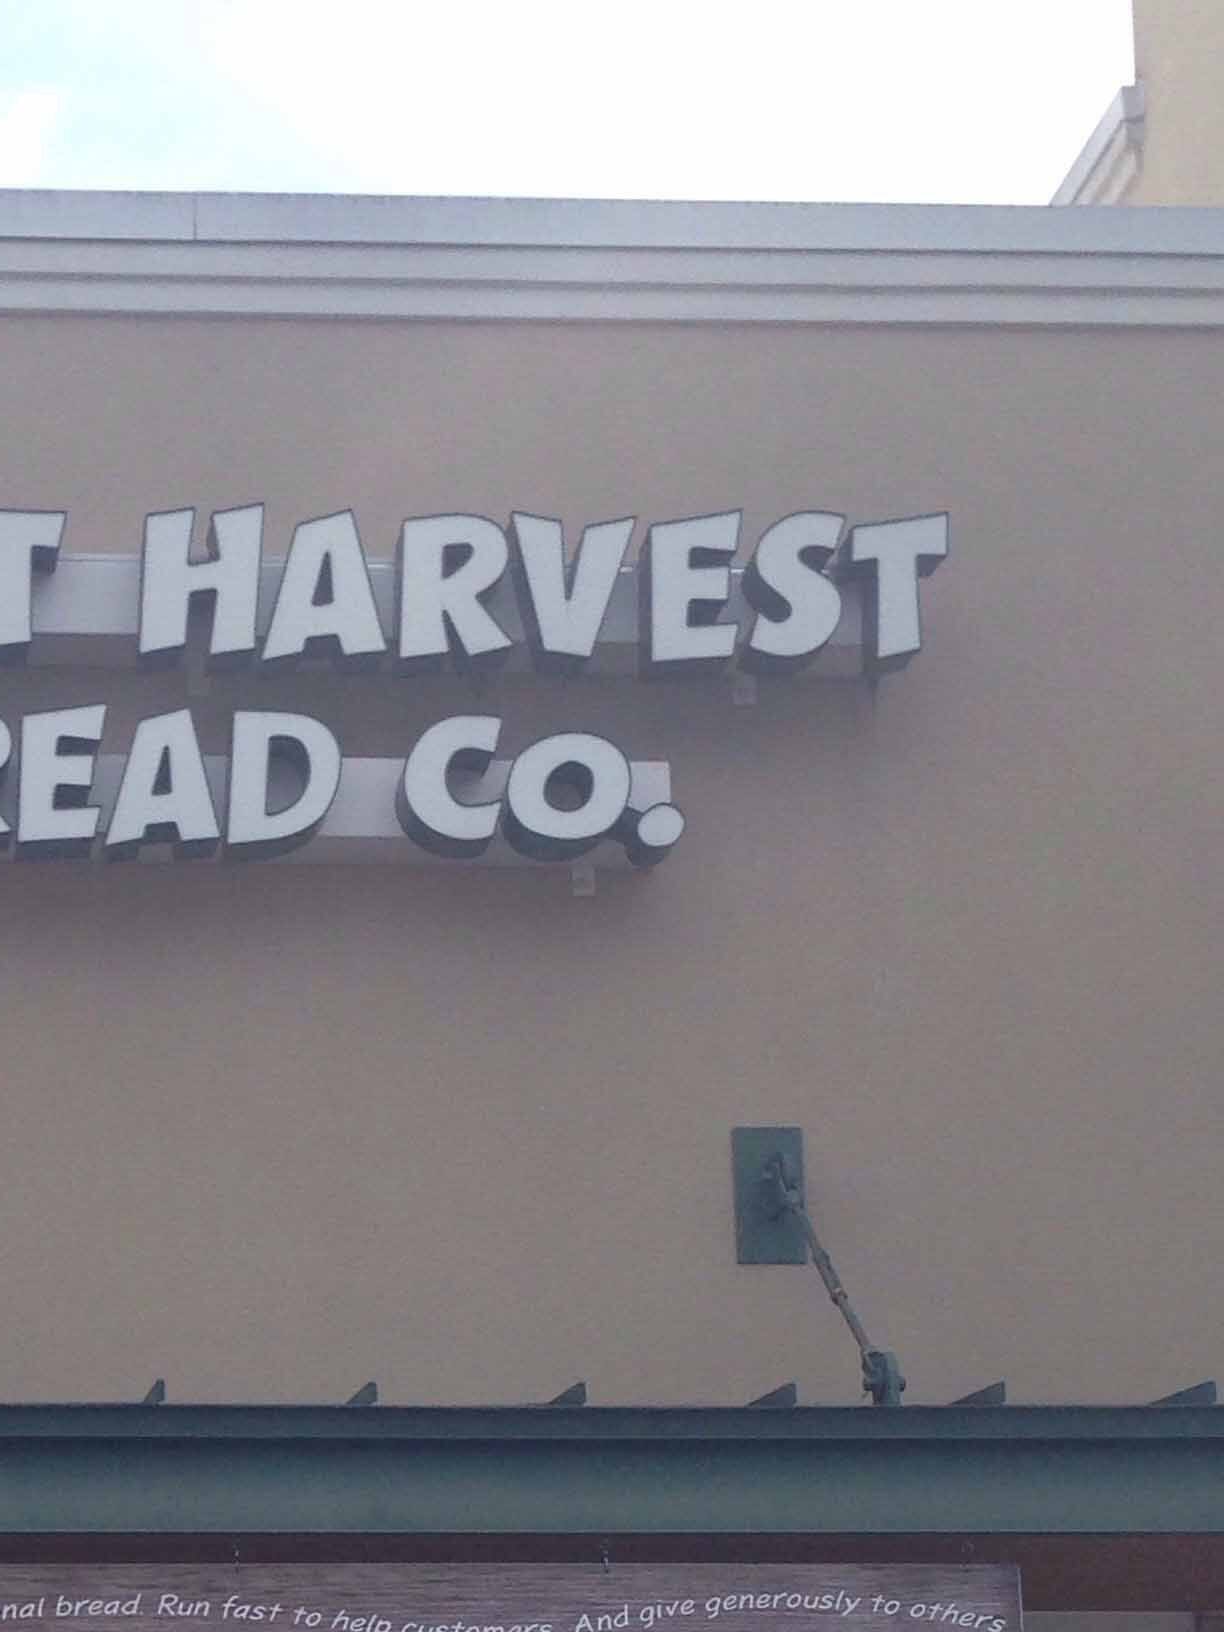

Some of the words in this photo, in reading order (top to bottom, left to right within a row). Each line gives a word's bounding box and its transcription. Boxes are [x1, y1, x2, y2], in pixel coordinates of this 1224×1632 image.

[136, 502, 950, 667] HARVEST
[158, 1592, 211, 1619] Run
[220, 1594, 282, 1621] fast
[293, 1604, 322, 1628] to
[640, 1599, 695, 1630] give
[705, 1588, 861, 1617] generously
[870, 1592, 900, 1616] to
